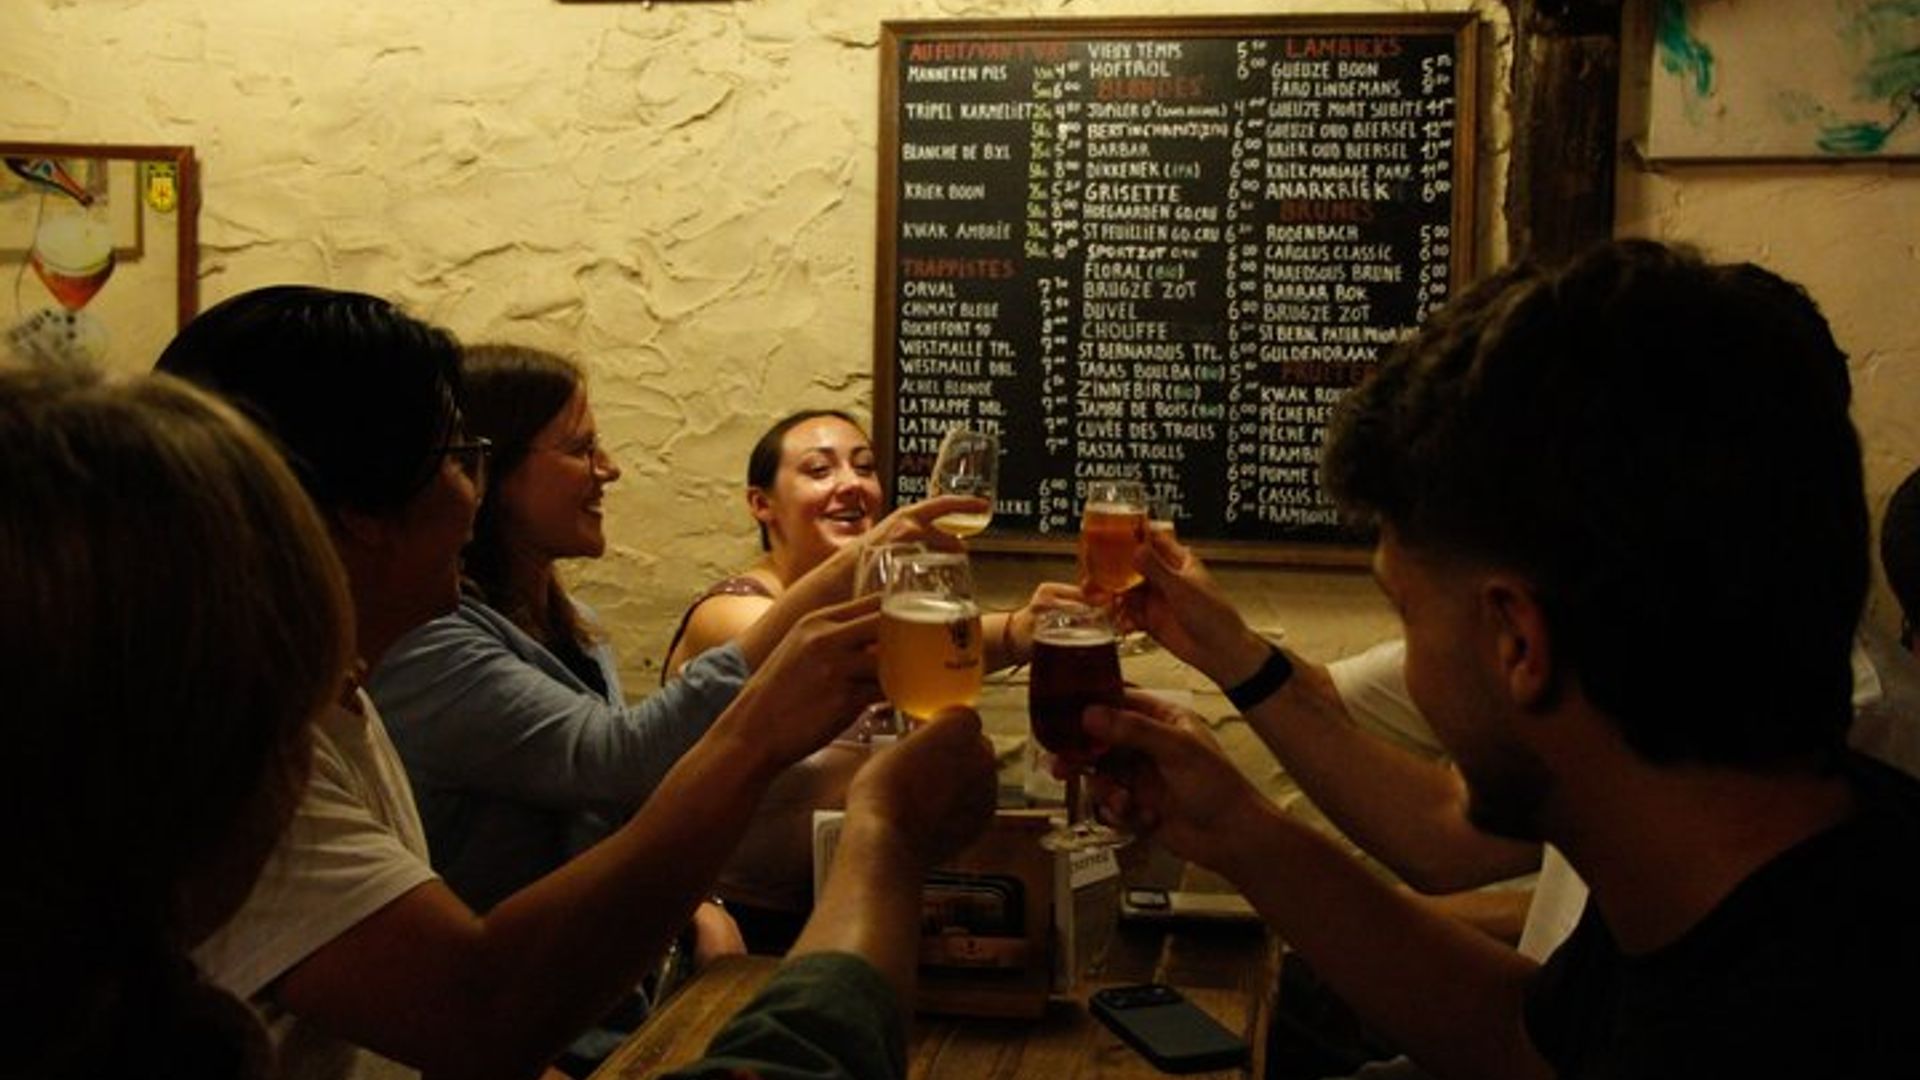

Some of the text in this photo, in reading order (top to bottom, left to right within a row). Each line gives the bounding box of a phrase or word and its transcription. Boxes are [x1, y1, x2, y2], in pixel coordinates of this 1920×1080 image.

[1338, 62, 1379, 79] BOON
[1087, 141, 1150, 158] BARBAR
[1085, 182, 1181, 201] GRISETTE
[1264, 180, 1391, 201] ANARKRIEK
[903, 221, 948, 239] KWAK
[1084, 262, 1142, 279] FLORAL
[903, 281, 956, 298] ORVAL
[1161, 280, 1197, 299] ZOT
[1083, 301, 1137, 319] DUVEL
[1082, 321, 1168, 340] CHOUFFE
[899, 340, 982, 358] WESTMALLE
[899, 359, 981, 376] WESTMALLE
[1128, 421, 1158, 440] DES
